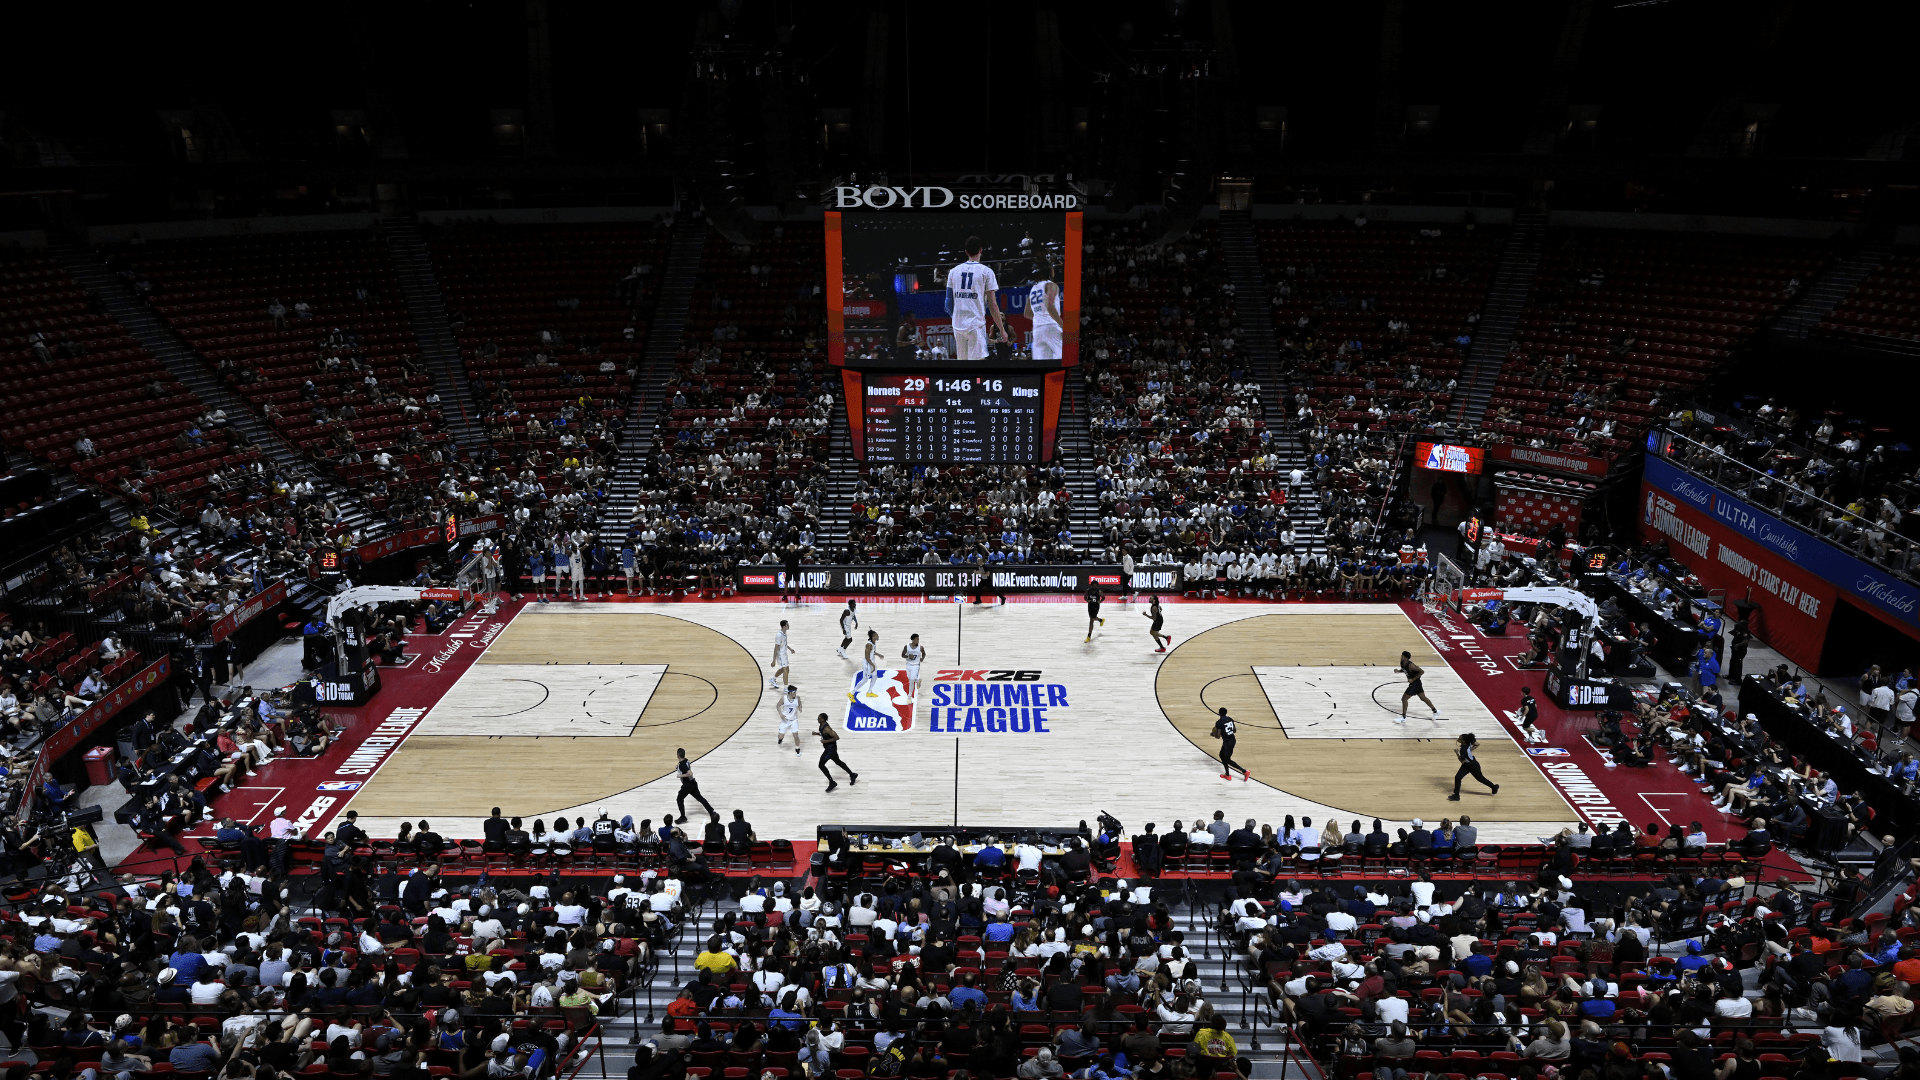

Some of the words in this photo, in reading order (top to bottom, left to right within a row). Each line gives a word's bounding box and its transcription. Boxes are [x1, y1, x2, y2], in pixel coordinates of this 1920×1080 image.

[835, 186, 954, 209] BOYD
[959, 194, 1077, 209] SCOREBOARD
[961, 272, 974, 290] 11
[1030, 289, 1044, 306] 22
[867, 386, 901, 396] Hornets
[904, 378, 925, 391] 29
[935, 379, 972, 392] 1:46
[982, 379, 1003, 392] 16
[1012, 387, 1039, 398] Kings
[945, 398, 962, 406] 1st
[980, 398, 991, 406] FLS
[994, 398, 1001, 406] 4
[1446, 449, 1470, 463] SUMMER
[1510, 448, 1588, 471] #NBA2KSummerLeague
[1443, 459, 1468, 473] LEAGUE
[1656, 496, 1677, 514] 2K26
[1671, 477, 1708, 505] Michelob
[1717, 499, 1756, 534] ULTRA
[1653, 507, 1684, 544] SUMMER
[1683, 523, 1711, 560] LEAGUE
[745, 576, 773, 584] Emirates
[845, 572, 865, 588] LIVE
[866, 572, 877, 588] IN
[878, 572, 894, 588] LAS
[896, 572, 926, 588] VEGAS
[936, 572, 956, 588] DEC.
[992, 571, 1077, 590] NBAEvents.com/cup
[1132, 572, 1151, 588] NBA
[1153, 572, 1172, 588] CUP
[1717, 543, 1758, 583] TOMORROW'S
[1757, 567, 1782, 596] STARS
[1779, 580, 1800, 606] PLAY
[1798, 591, 1821, 619] HERE
[1856, 574, 1916, 613] Michelob
[422, 638, 464, 674] Michelob
[459, 608, 490, 632] ULTR
[1459, 641, 1504, 676] ULTRA
[934, 669, 1043, 681] 2K26
[326, 682, 338, 701] iD
[337, 683, 351, 692] JOIN
[931, 683, 1070, 707] SUMMER
[1580, 685, 1592, 705] iD
[1592, 686, 1605, 695] JOIN
[338, 692, 355, 701] TODAY
[1592, 695, 1609, 704] TODAY
[854, 716, 888, 729] NBA
[929, 707, 1051, 733] LEAGUE
[335, 736, 401, 775] SUMMER
[370, 706, 428, 736] LEAGUE
[1541, 762, 1611, 805] SUMMER
[292, 795, 338, 832] K26
[627, 897, 640, 909] 93
